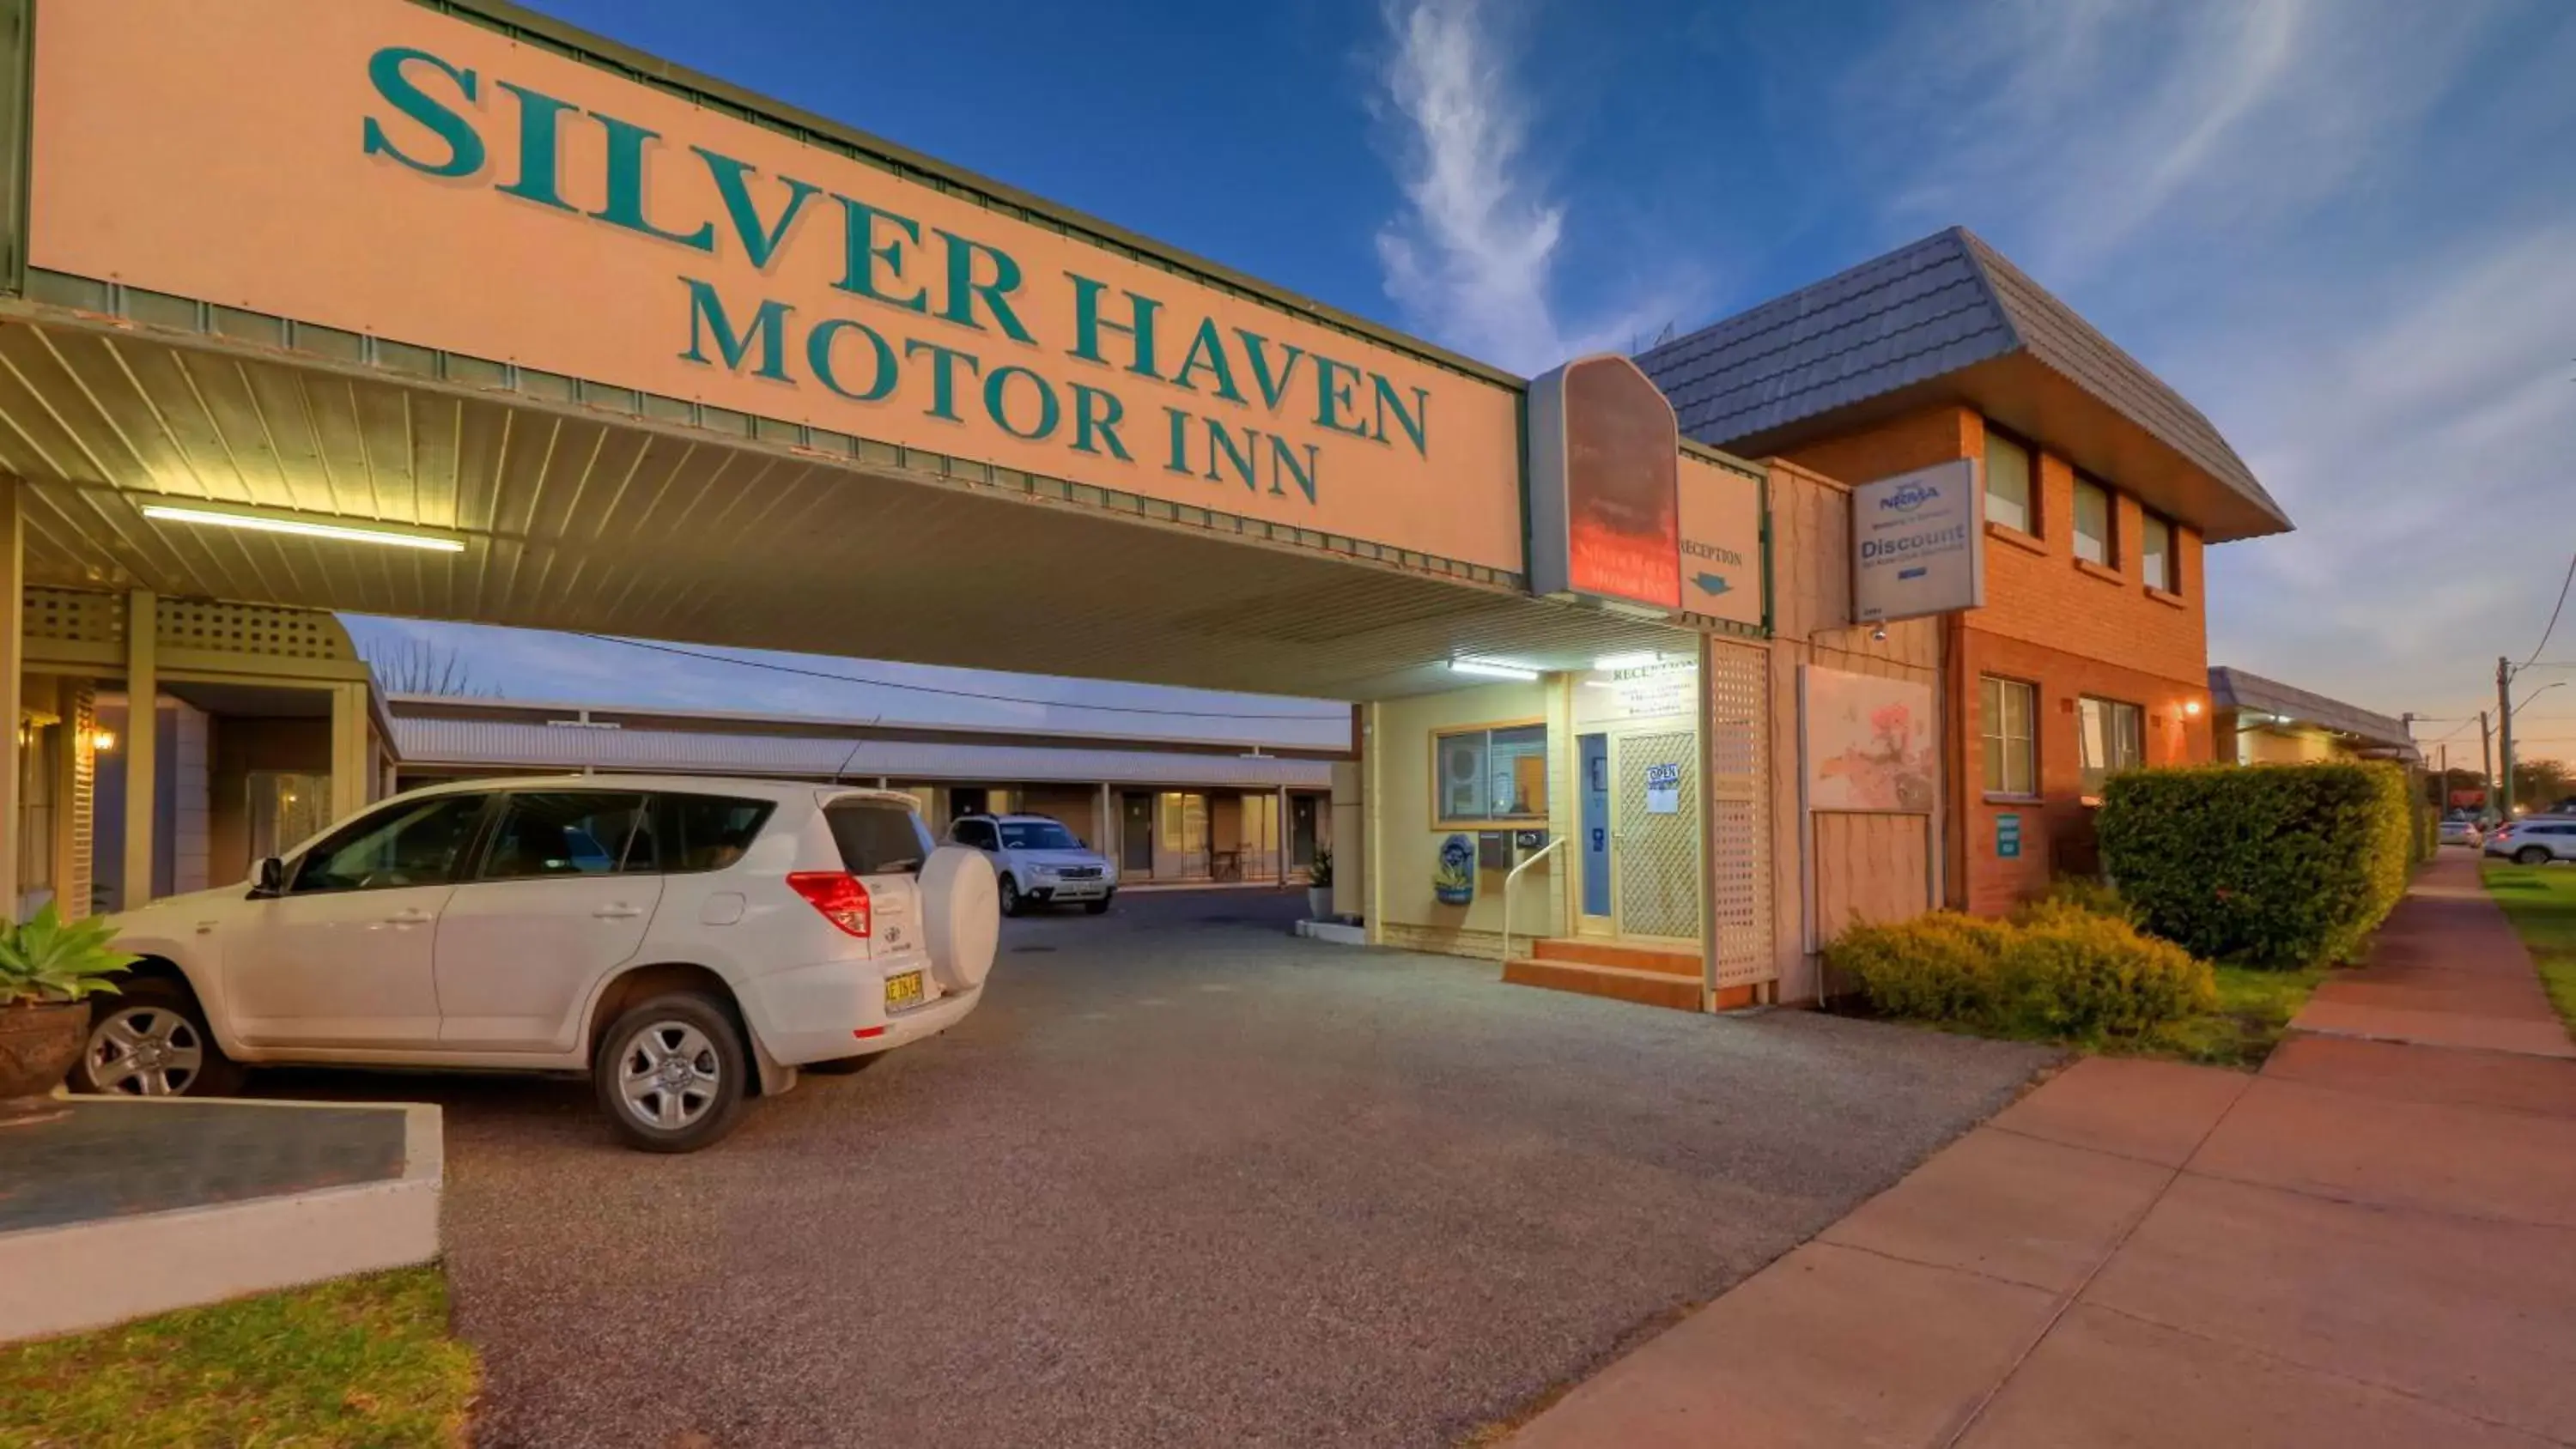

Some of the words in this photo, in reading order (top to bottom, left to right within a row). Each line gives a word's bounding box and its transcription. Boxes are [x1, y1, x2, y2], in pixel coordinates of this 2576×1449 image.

[363, 46, 1038, 345] SILVER
[1063, 270, 1430, 460] HAVEN
[677, 276, 1135, 464] MOTOR
[1162, 405, 1320, 506] INN
[1861, 524, 1965, 559] Discount
